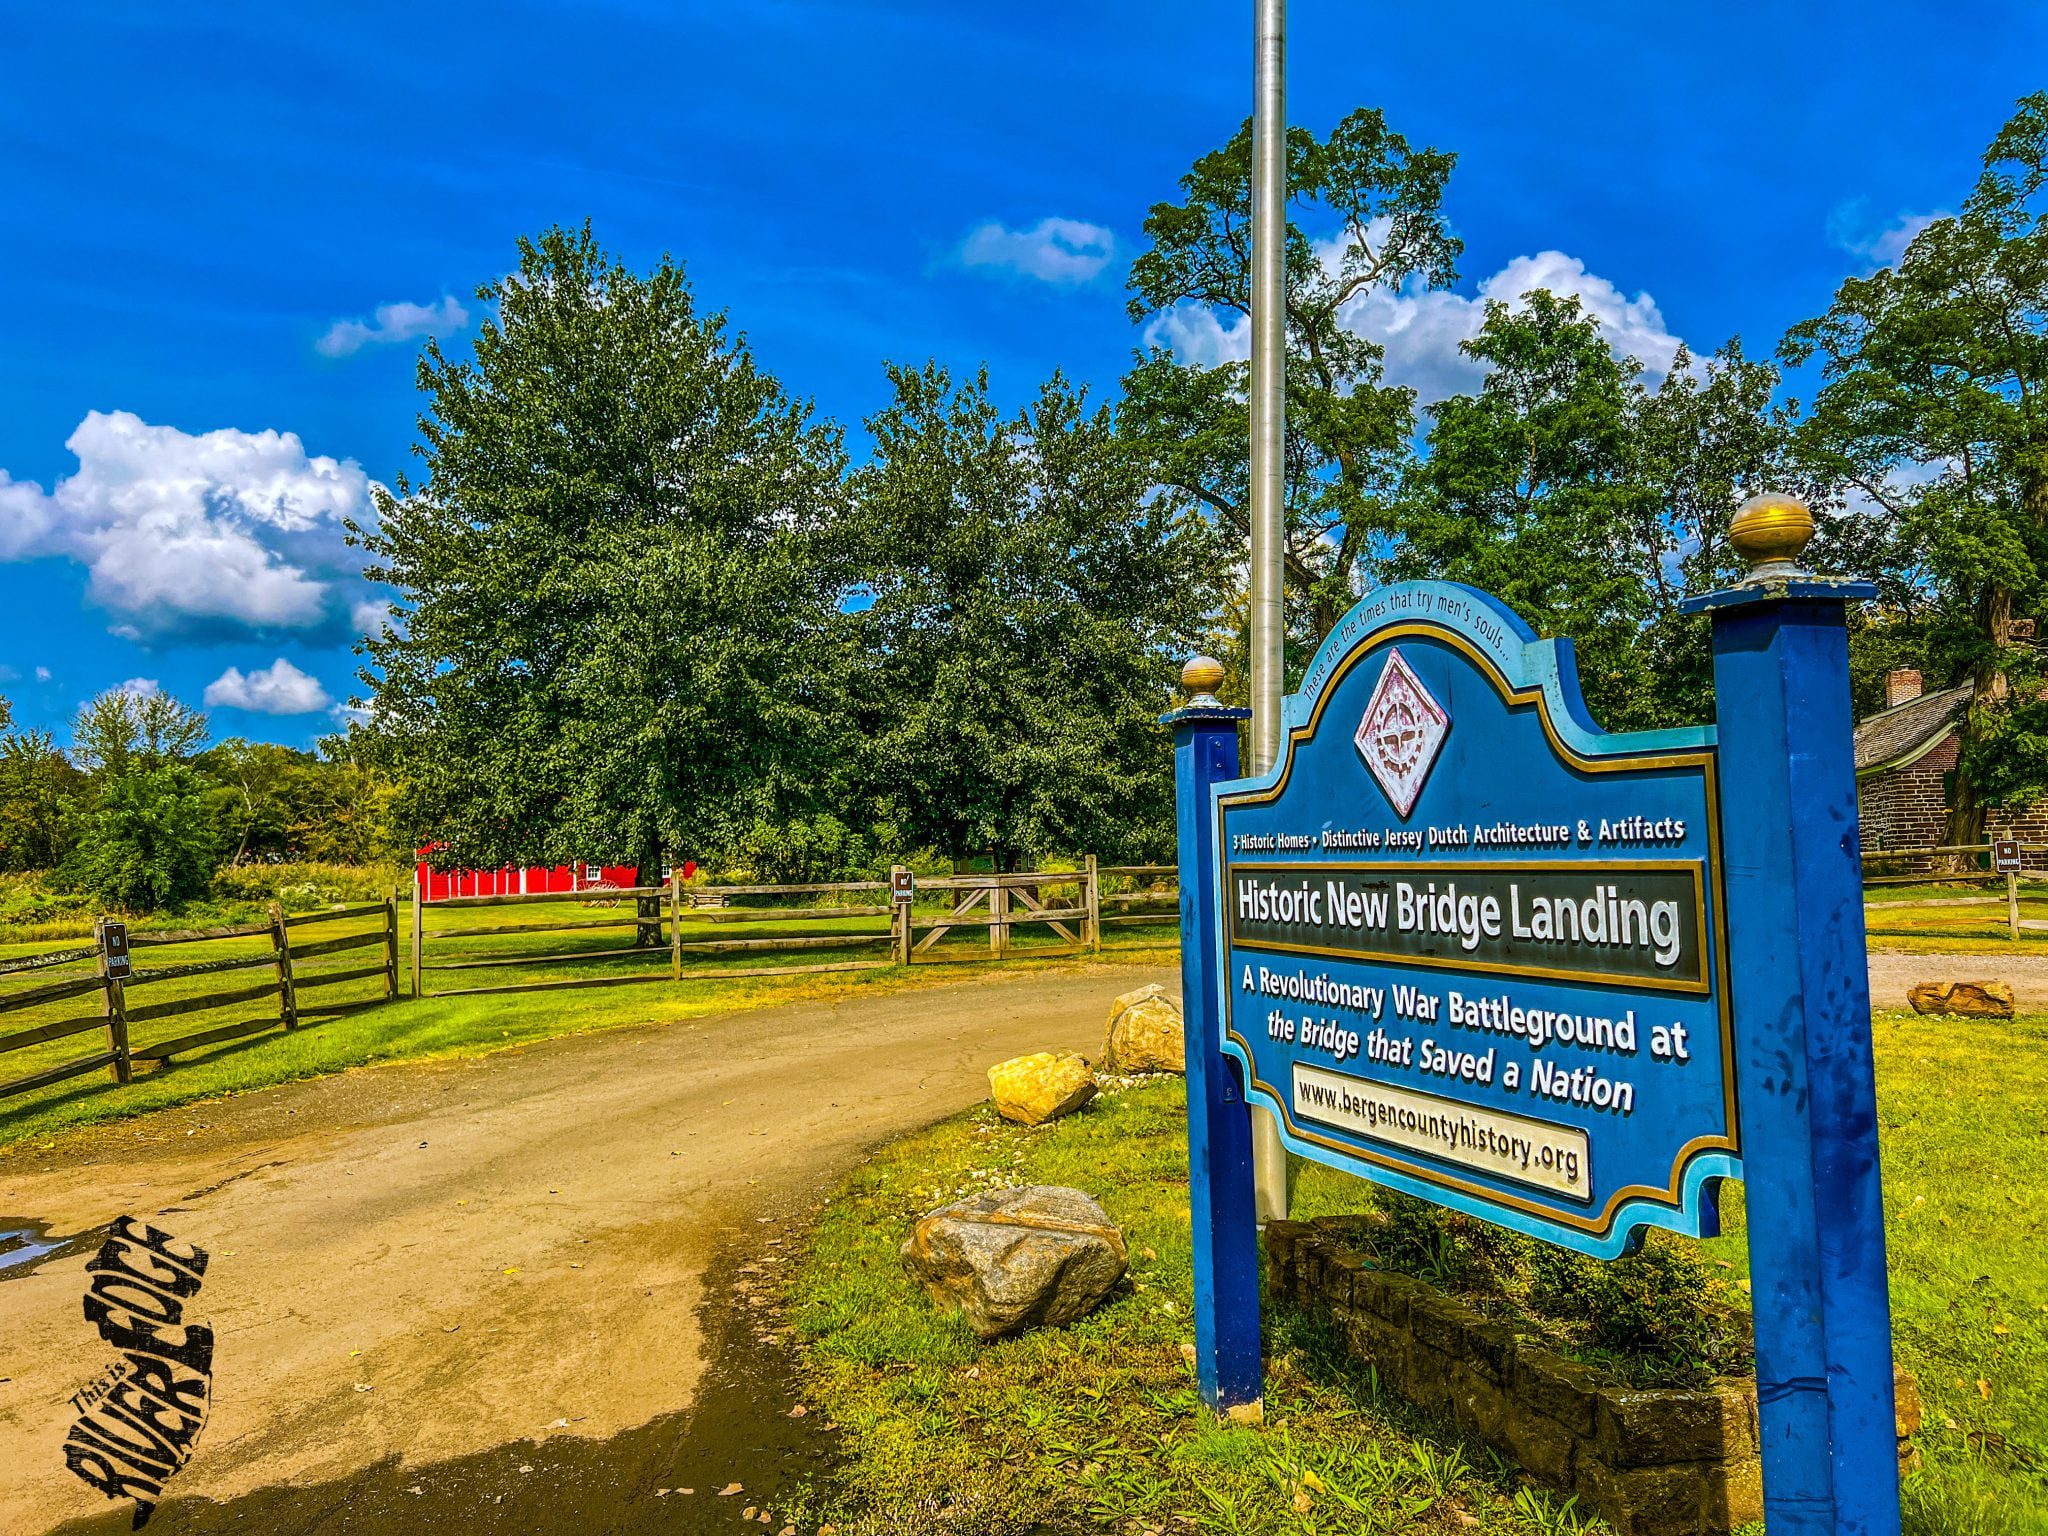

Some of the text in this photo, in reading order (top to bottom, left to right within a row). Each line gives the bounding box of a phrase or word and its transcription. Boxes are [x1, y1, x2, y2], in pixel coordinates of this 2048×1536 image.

[1303, 663, 1326, 701] These
[1326, 640, 1340, 663] are
[1341, 620, 1357, 643] the
[1359, 600, 1386, 627] times
[1390, 590, 1412, 610] that
[1417, 592, 1432, 613] try
[1437, 596, 1471, 622] men's
[1233, 815, 1685, 850] 3 Historic Homes Distinctive Jersey Dutch Architecture & Artifacts
[108, 954, 129, 967] PARKING
[112, 935, 120, 947] NO
[1238, 879, 1680, 966] Historic New Bridge Landing
[1242, 965, 1689, 1059] A Revolutionary War Battleground at
[1267, 1009, 1634, 1112] the Bridge that Saved a Nation
[1299, 1081, 1579, 1178] www.bergencountyhistory.org
